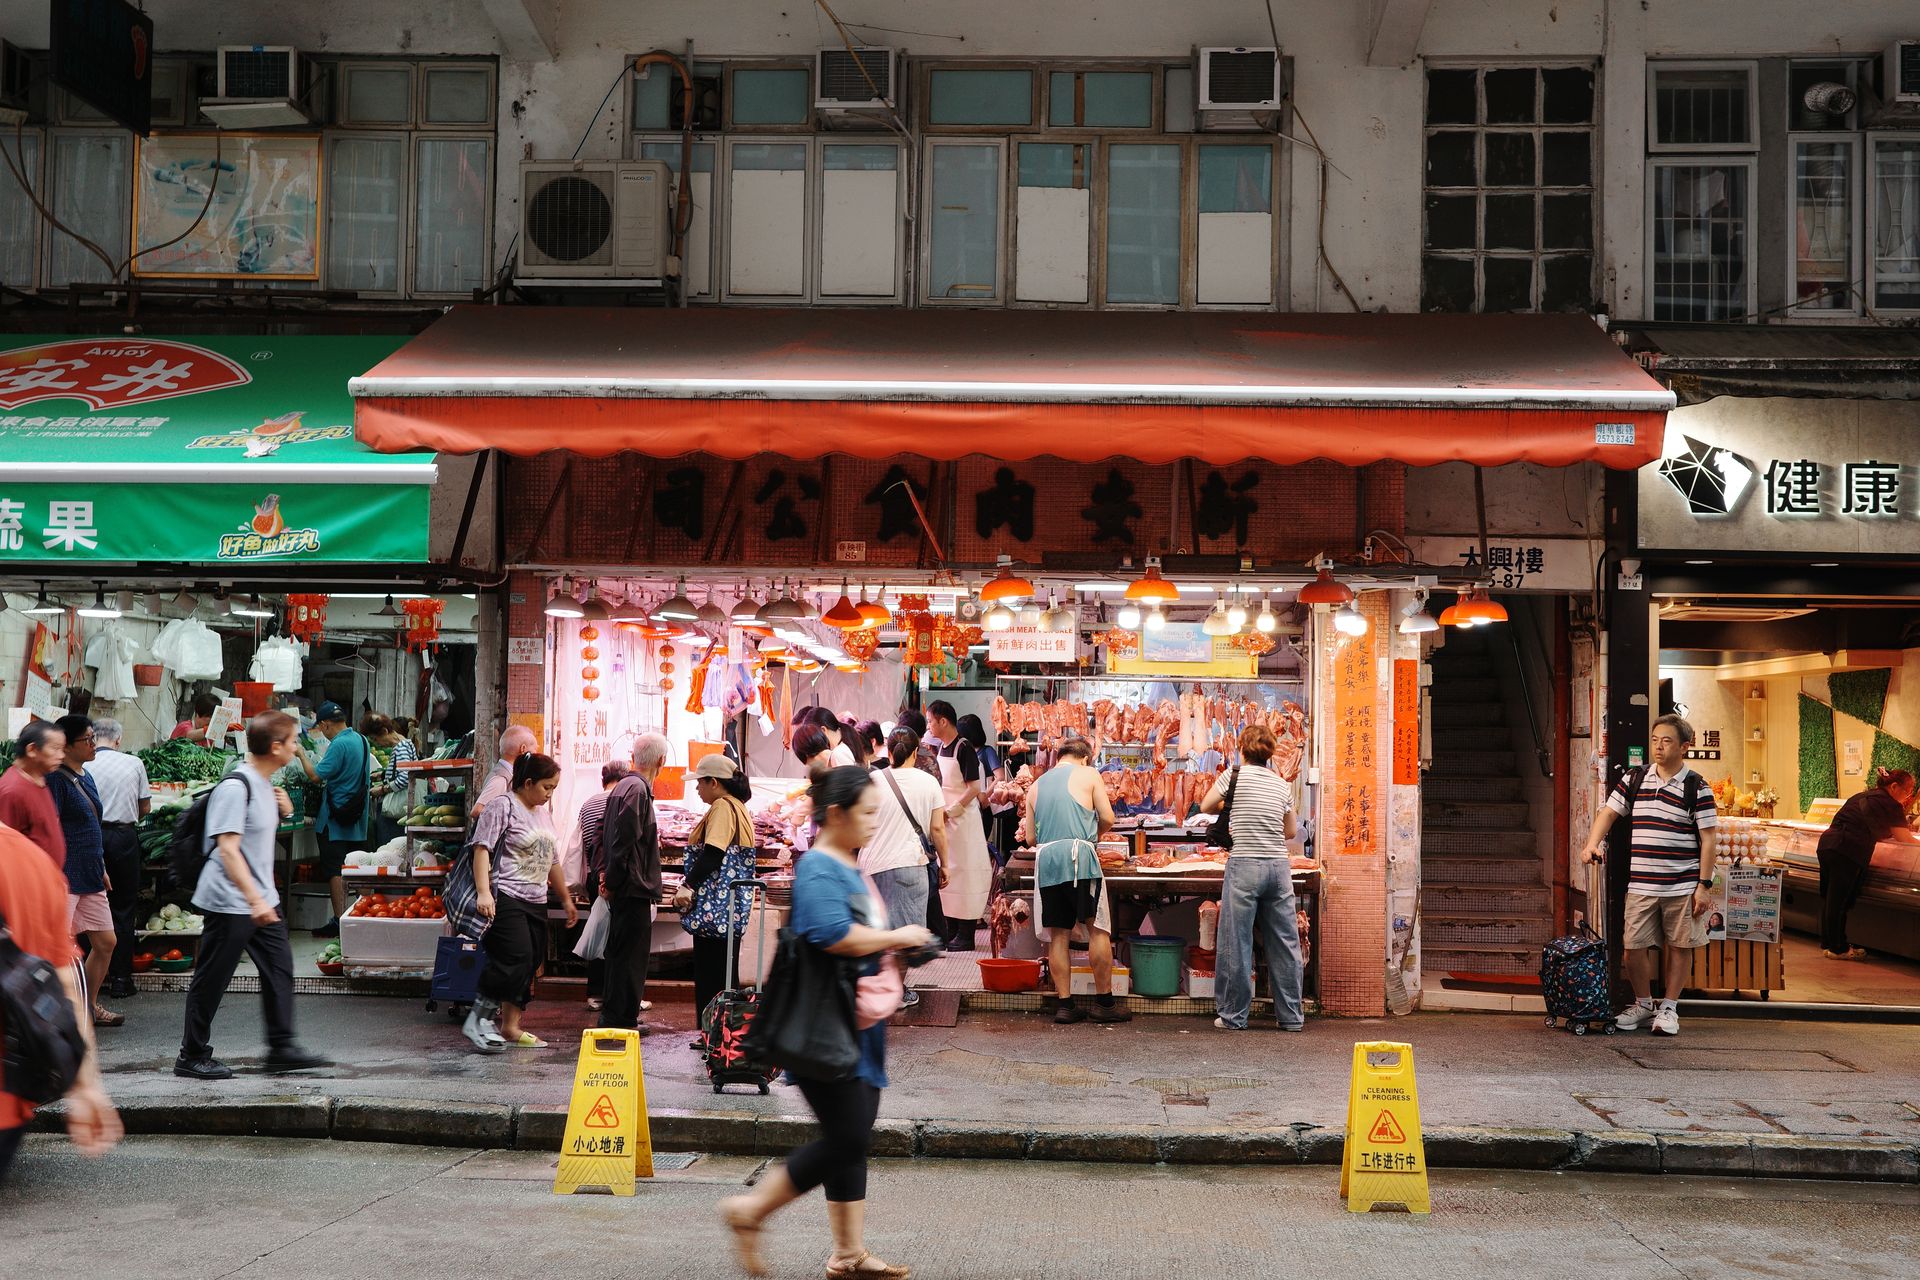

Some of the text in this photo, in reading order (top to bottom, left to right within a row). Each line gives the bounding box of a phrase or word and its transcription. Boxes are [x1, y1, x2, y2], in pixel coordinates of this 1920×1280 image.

[84, 344, 152, 357] Anjoy
[1597, 434, 1634, 444] 2573 8742
[1763, 459, 1900, 514] 健康
[220, 530, 319, 557] 好魚做好丸
[844, 552, 857, 560] 85
[1459, 546, 1544, 573] 大興樓
[1016, 626, 1037, 634] MEAT
[996, 639, 1066, 651] 新鮮肉出售
[588, 1072, 625, 1080] CAUTION
[602, 1080, 629, 1088] FLOOR
[573, 1135, 625, 1154] 小心地滑
[1361, 1152, 1416, 1171] 工作进行中
